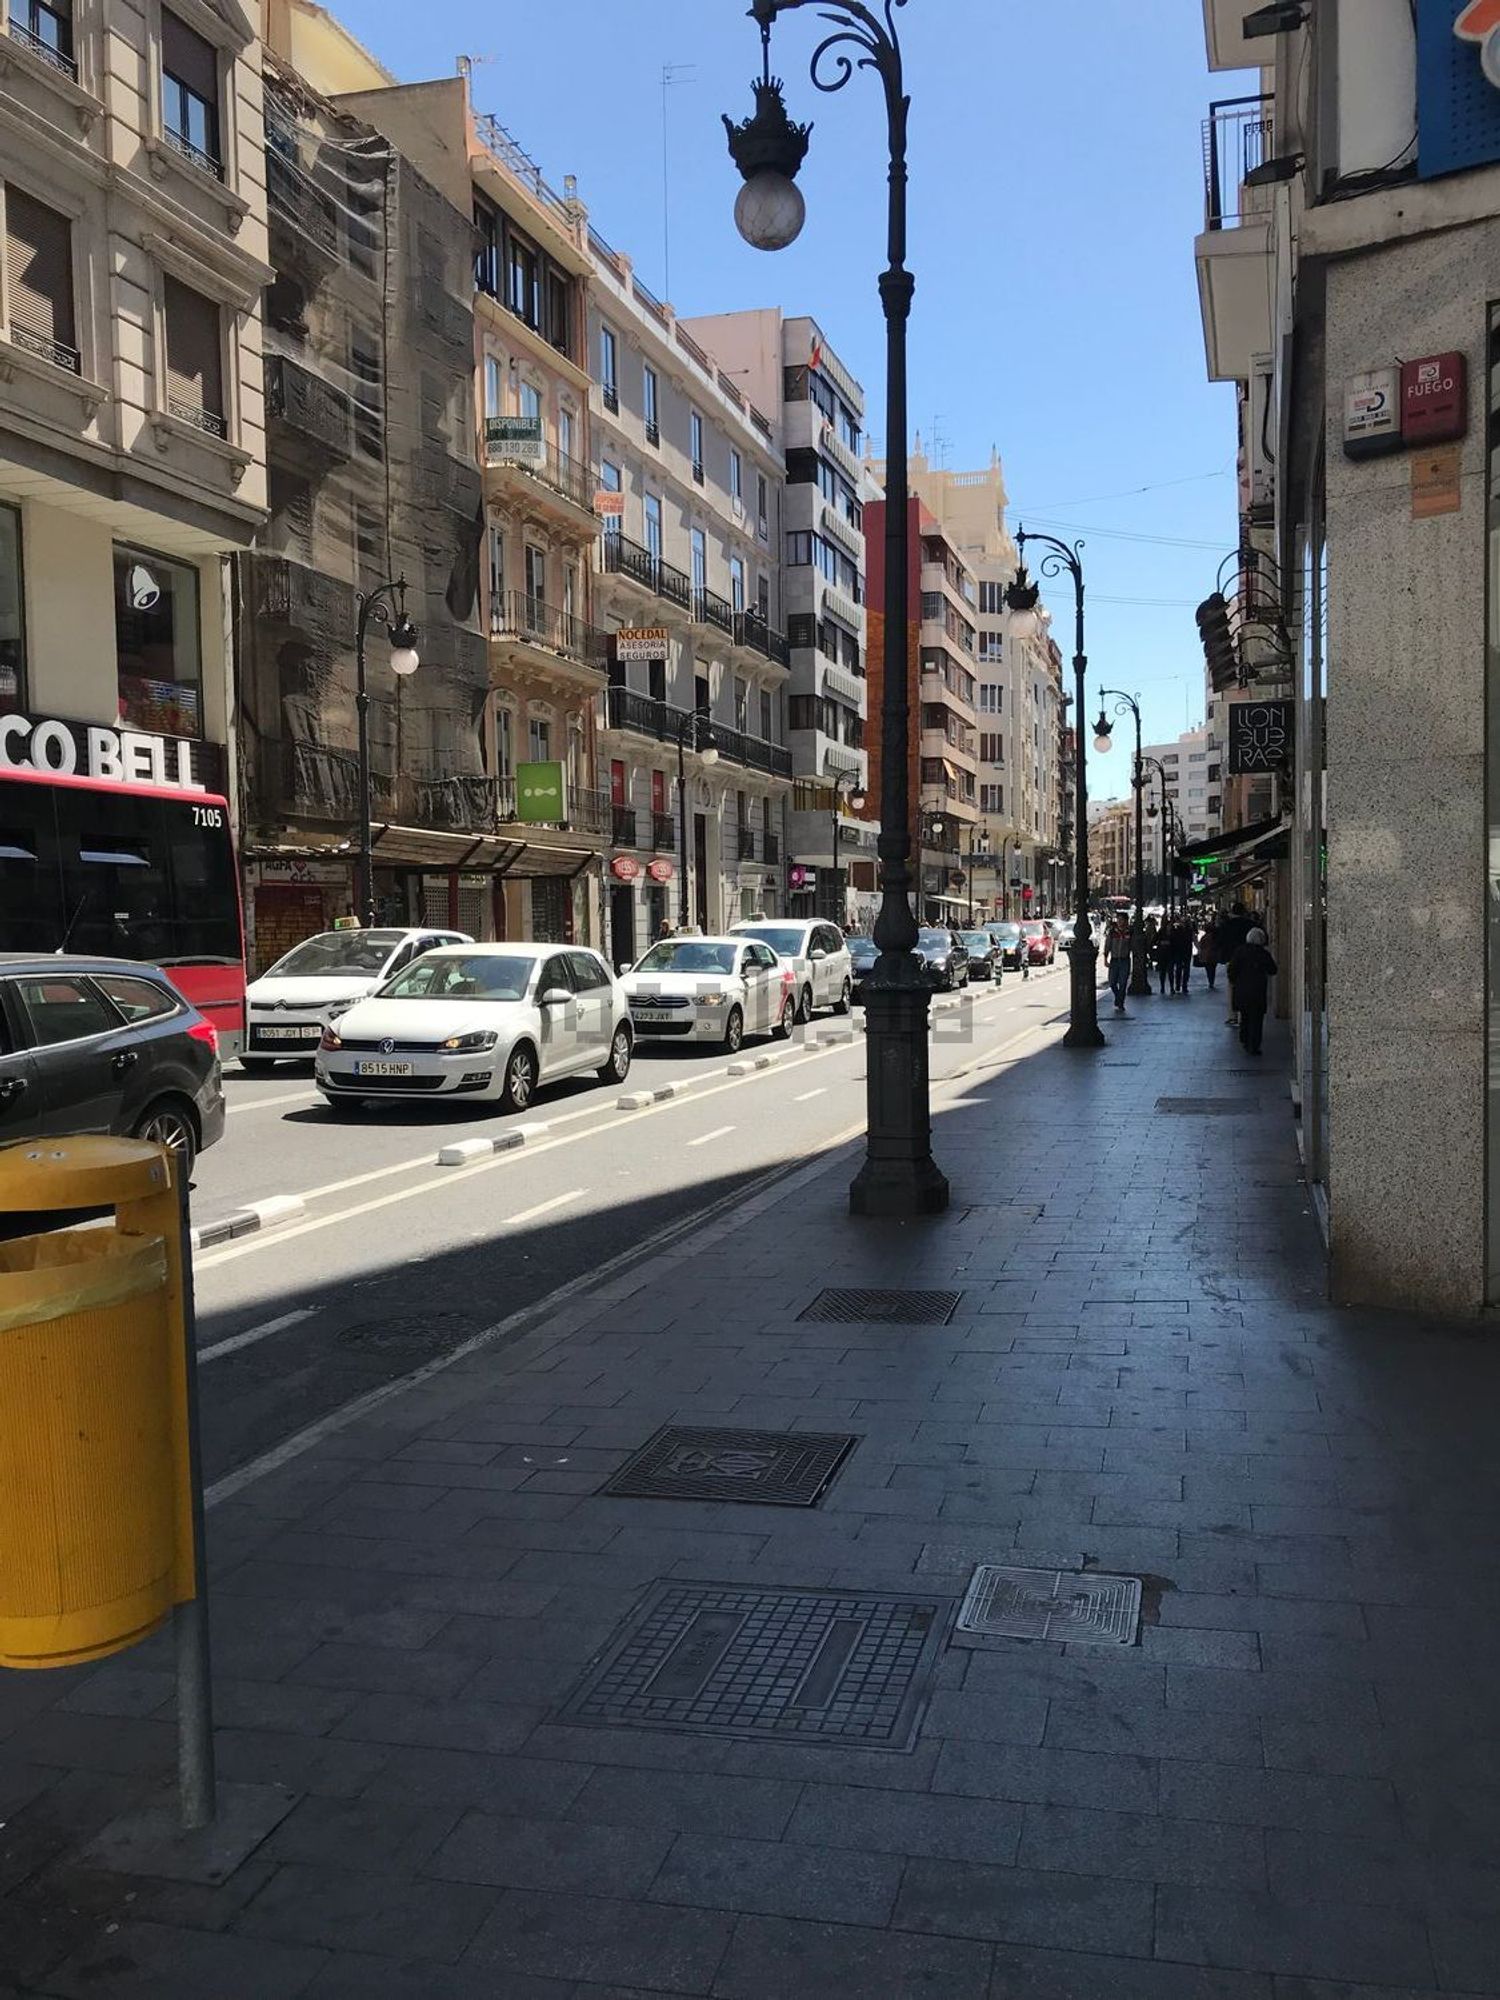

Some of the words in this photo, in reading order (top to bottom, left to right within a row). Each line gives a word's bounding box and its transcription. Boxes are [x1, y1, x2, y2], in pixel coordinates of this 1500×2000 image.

[1407, 377, 1454, 398] FUEGO
[489, 418, 538, 430] DISPONIBLE
[618, 629, 667, 640] NOCEDAL
[620, 651, 666, 660] SEGUROS
[87, 727, 206, 793] BELL
[192, 807, 222, 828] 7105
[361, 1063, 388, 1074] 8515
[389, 1064, 409, 1075] HNP
